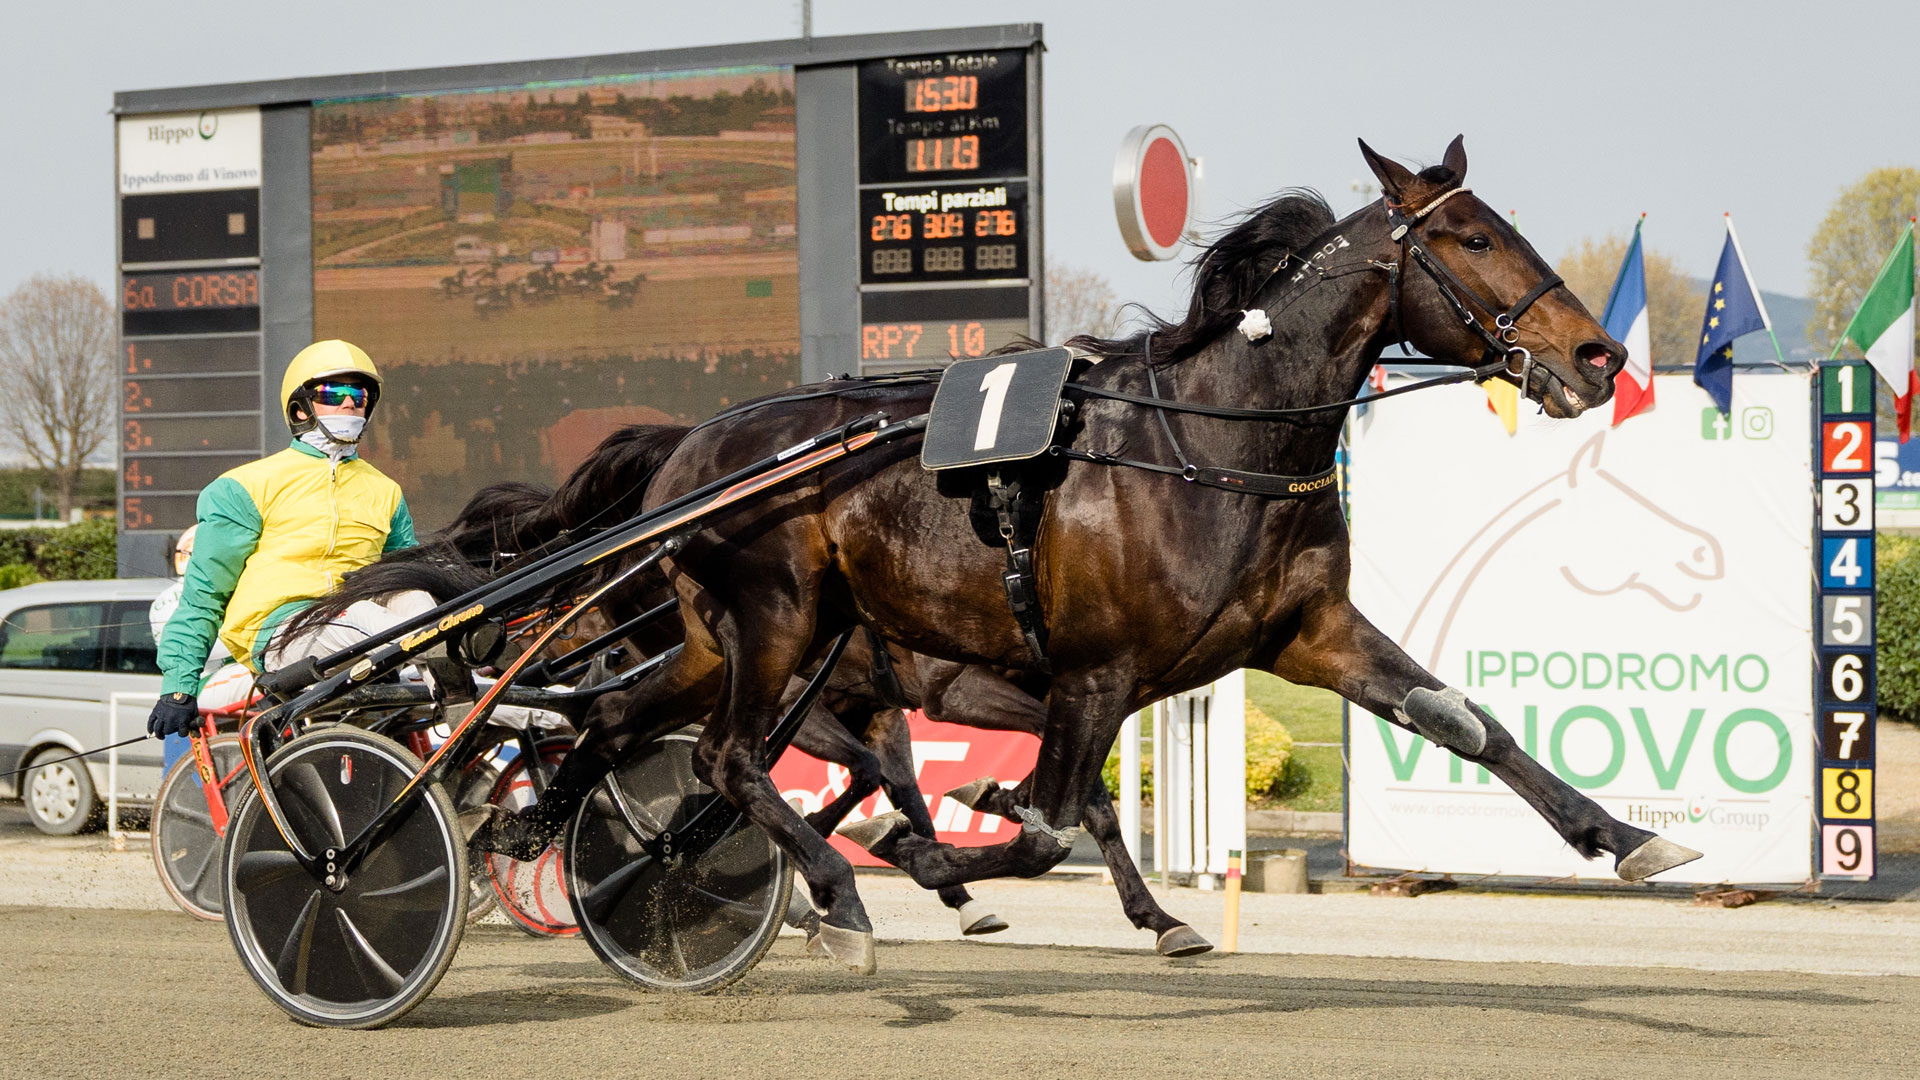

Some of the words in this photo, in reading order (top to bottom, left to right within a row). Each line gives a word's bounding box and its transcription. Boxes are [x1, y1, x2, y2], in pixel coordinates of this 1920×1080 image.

[148, 125, 194, 144] Hippo
[122, 171, 194, 190] Ippodromo
[197, 169, 210, 182] di
[212, 167, 257, 181] Vinovo
[882, 190, 938, 214] Tempi
[941, 186, 1007, 212] parziali
[172, 273, 258, 308] CORSA
[862, 324, 923, 359] RP7
[947, 322, 985, 357] 10
[974, 362, 1017, 450] 1
[1838, 365, 1854, 413] 1
[1832, 422, 1863, 469] 2
[1834, 483, 1861, 525] 3
[1830, 538, 1862, 585] 4
[1832, 597, 1863, 644] 5
[1466, 650, 1769, 693] IPPODROMO
[1832, 654, 1864, 701] 6
[1833, 712, 1865, 759] 7
[1835, 770, 1861, 814] 8
[1628, 804, 1686, 829] Hippo
[1708, 806, 1770, 832] Group
[1835, 828, 1862, 871] 9
